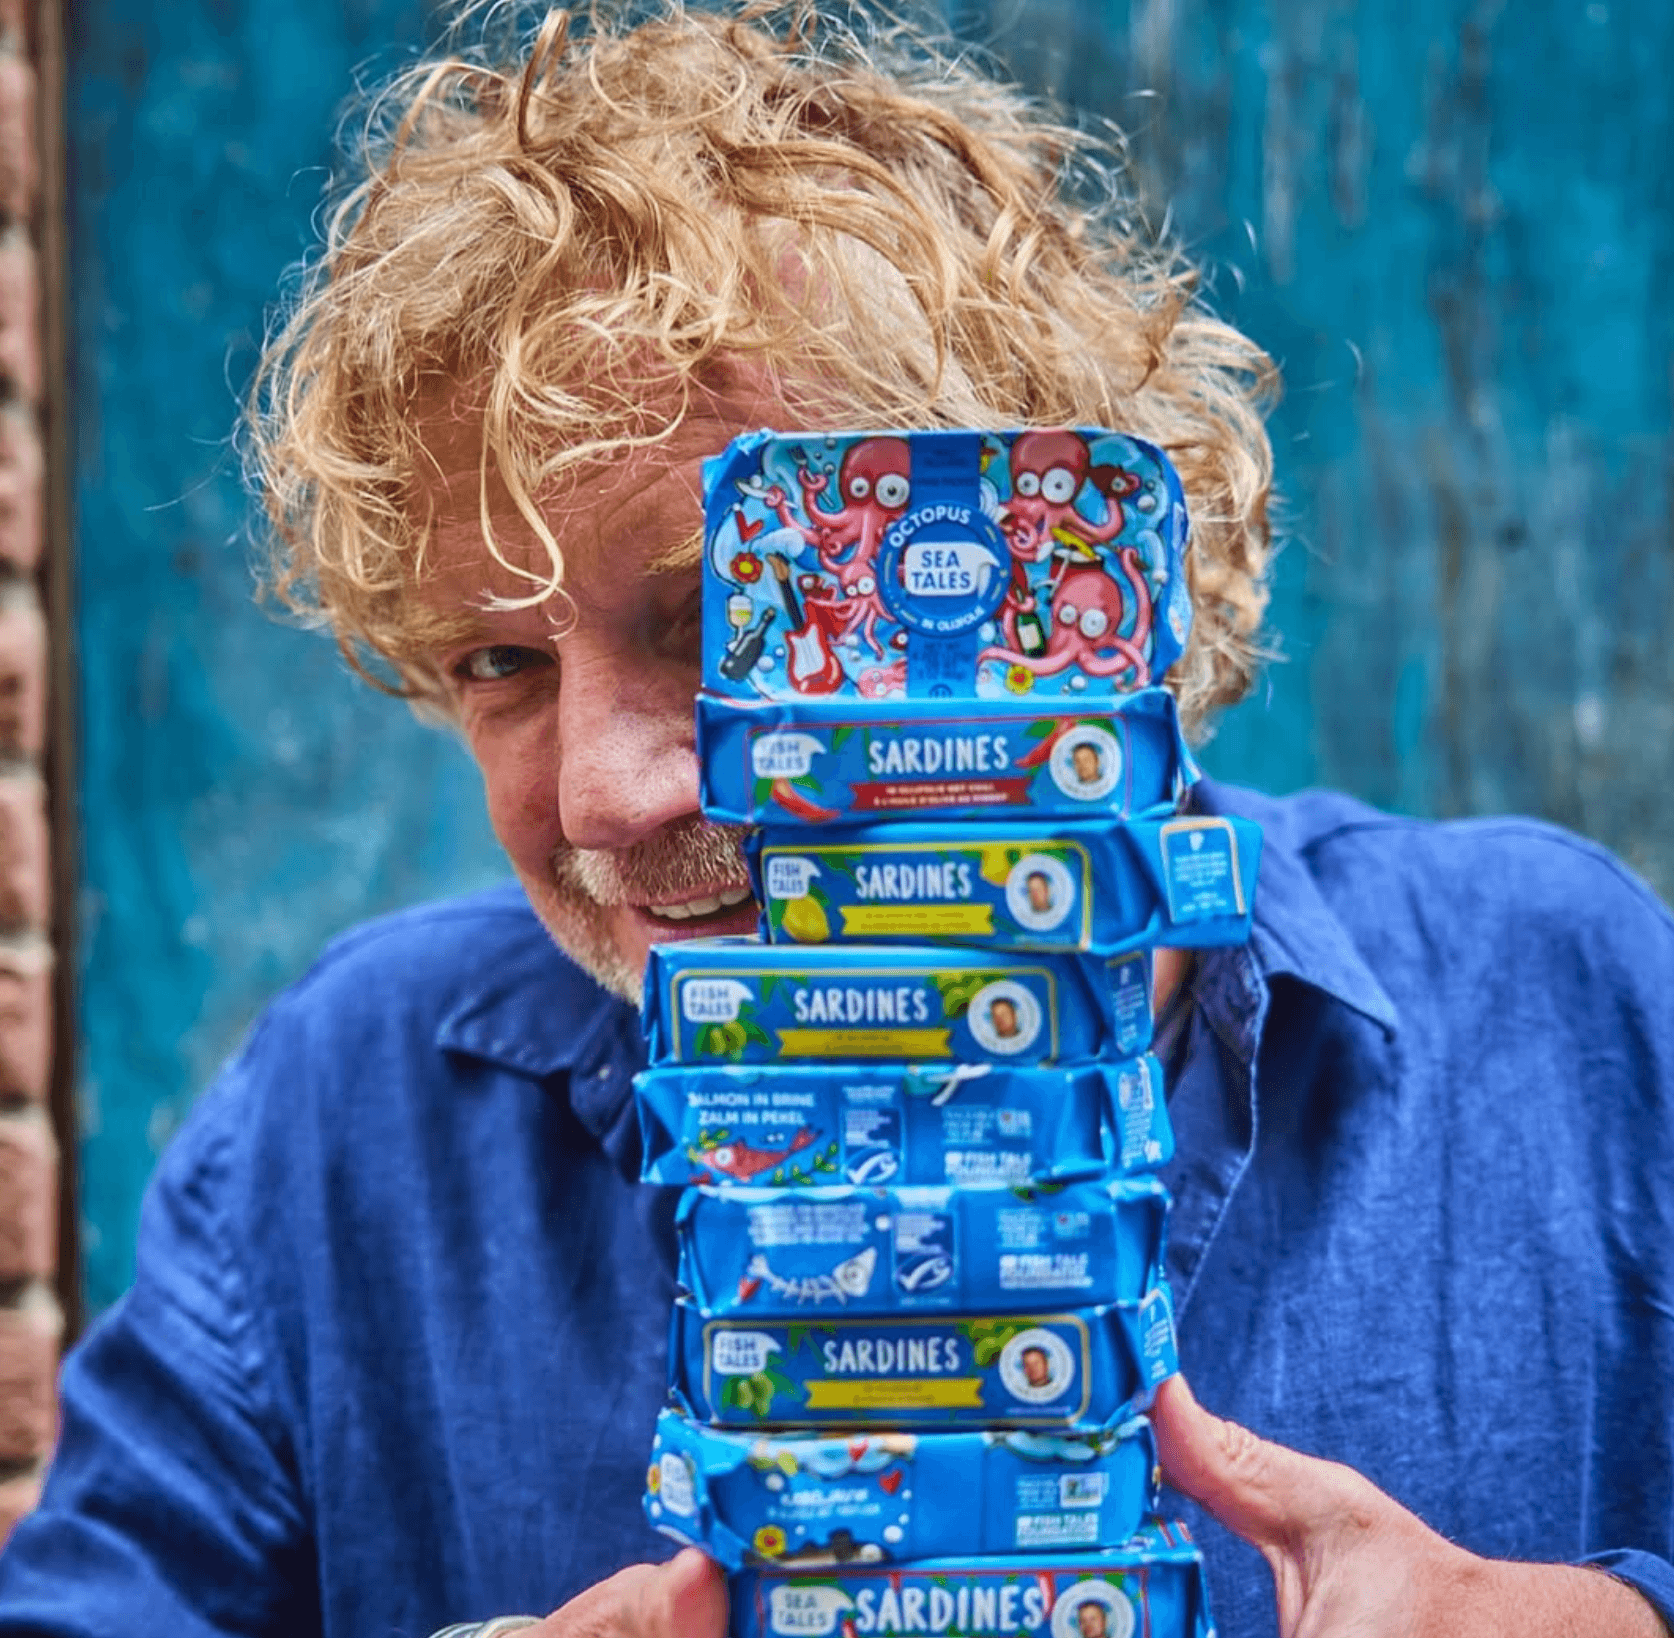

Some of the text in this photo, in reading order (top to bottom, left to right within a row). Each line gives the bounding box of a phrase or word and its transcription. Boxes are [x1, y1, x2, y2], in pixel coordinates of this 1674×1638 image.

[889, 505, 971, 547] OCTOPUS
[921, 550, 960, 568] SEA
[911, 571, 971, 589] TALES
[760, 741, 799, 755] ISH
[868, 735, 1009, 774] SARDINES
[773, 863, 801, 876] FISH
[773, 879, 805, 893] TALES
[855, 862, 972, 899] SARDINES
[690, 987, 730, 999] FISH
[690, 1002, 733, 1016] TALES
[794, 987, 928, 1023] SARDINES
[687, 1091, 750, 1107] SALMON
[753, 1092, 769, 1106] IN
[699, 1110, 739, 1125] ZALM
[742, 1111, 759, 1125] IN
[720, 1337, 757, 1350] FISH
[719, 1353, 760, 1367] TALES
[823, 1336, 960, 1374] SARDINES
[785, 1593, 817, 1609] SEA
[854, 1585, 1045, 1632] SARDINES
[779, 1610, 828, 1627] TALES
